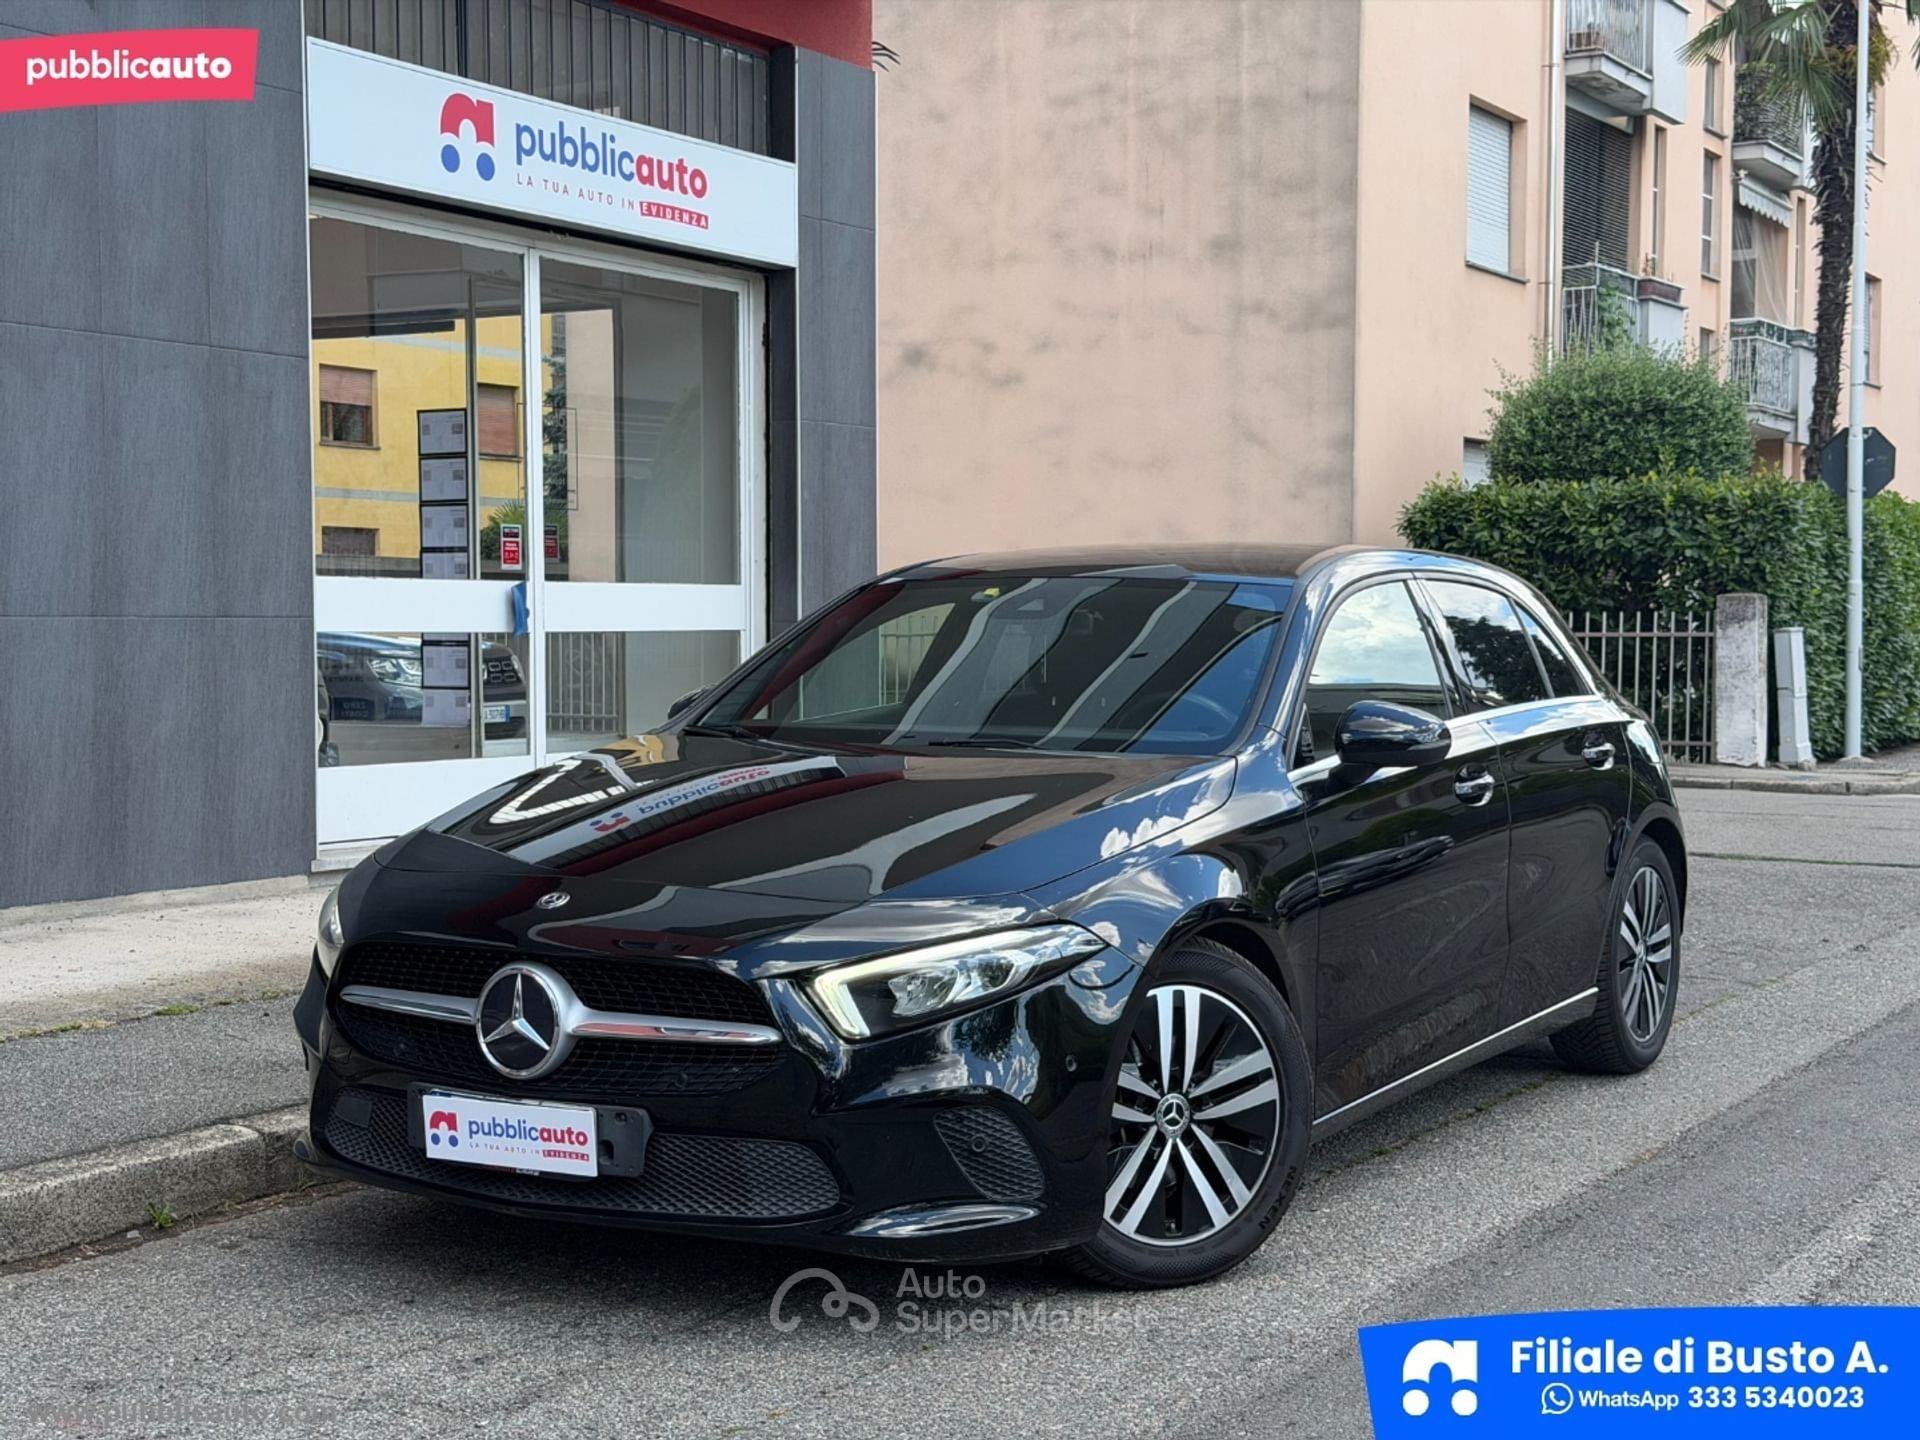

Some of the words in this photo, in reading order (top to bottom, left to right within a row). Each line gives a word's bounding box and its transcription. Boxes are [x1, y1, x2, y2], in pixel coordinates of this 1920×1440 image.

[516, 121, 708, 199] pubblicauto
[516, 173, 535, 187] LA
[542, 179, 570, 196] TUA
[578, 188, 615, 206] AUTO
[621, 199, 636, 210] IN
[641, 203, 707, 229] EVIDENZA
[468, 1116, 588, 1147] pubblicauto
[504, 1145, 527, 1154] AUTO
[543, 1149, 589, 1161] EVIDENZA
[1258, 1165, 1297, 1231] NEXEN
